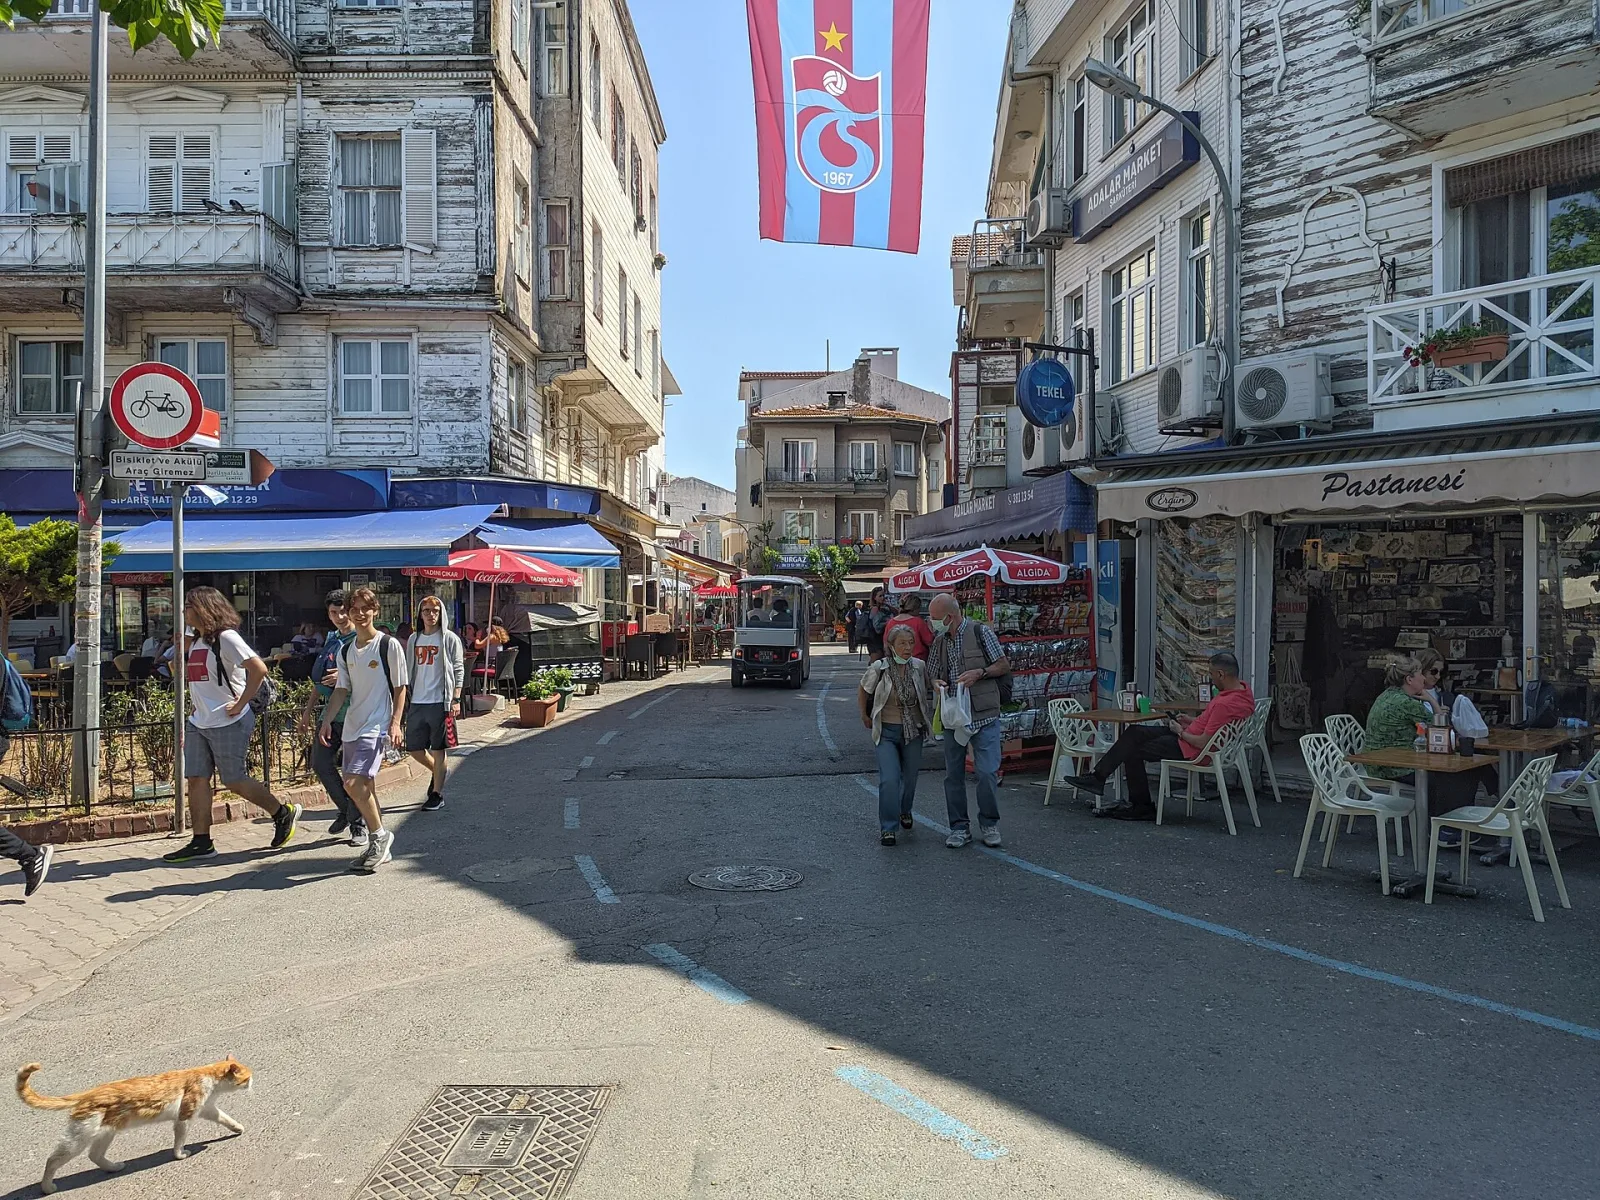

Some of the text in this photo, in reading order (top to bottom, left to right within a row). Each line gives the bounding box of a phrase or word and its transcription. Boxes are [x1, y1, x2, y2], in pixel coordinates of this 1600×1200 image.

[823, 171, 854, 186] 1967
[1087, 138, 1162, 214] ADALAR MARKET
[1036, 385, 1065, 399] TEKEL
[115, 456, 202, 466] Bisiklet ve Akülü
[125, 467, 194, 476] Araç Giremez
[1322, 468, 1466, 502] Pastanesi
[151, 495, 174, 504] HAT
[185, 496, 209, 504] 0216
[231, 496, 243, 504] 12
[245, 496, 258, 504] 29
[953, 501, 974, 519] ADALAR
[974, 495, 996, 513] MARKET
[1027, 489, 1034, 500] 54
[1157, 493, 1186, 508] Ergün
[441, 570, 459, 578] ÇIKAR
[473, 571, 516, 583] Coca-Cola
[489, 1123, 524, 1158] TELEKOM
